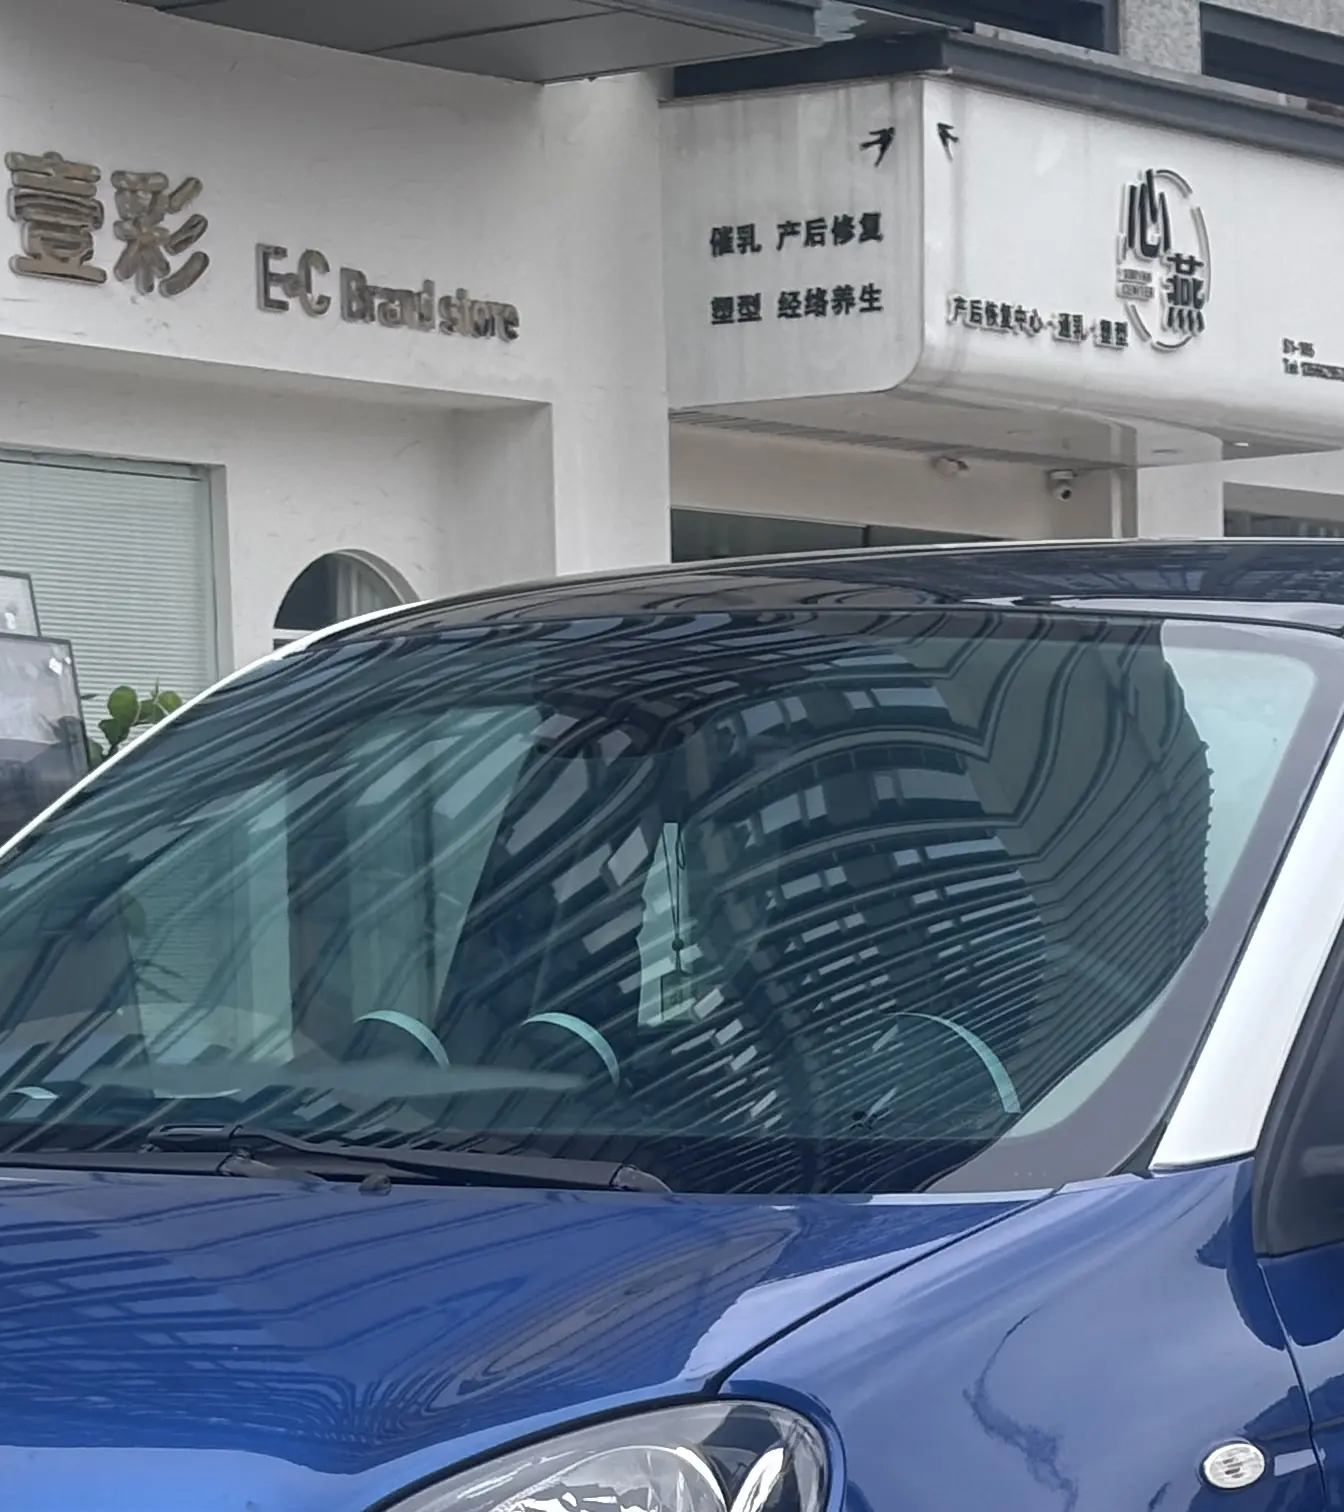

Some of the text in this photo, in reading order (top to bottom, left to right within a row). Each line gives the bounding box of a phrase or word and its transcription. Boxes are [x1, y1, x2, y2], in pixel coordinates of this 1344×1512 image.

[4, 150, 209, 298] 壹彩
[710, 212, 884, 257] 催乳 产后修复
[340, 266, 435, 333] Brand
[438, 287, 521, 343] store
[711, 282, 884, 325] 塑型 经络养生
